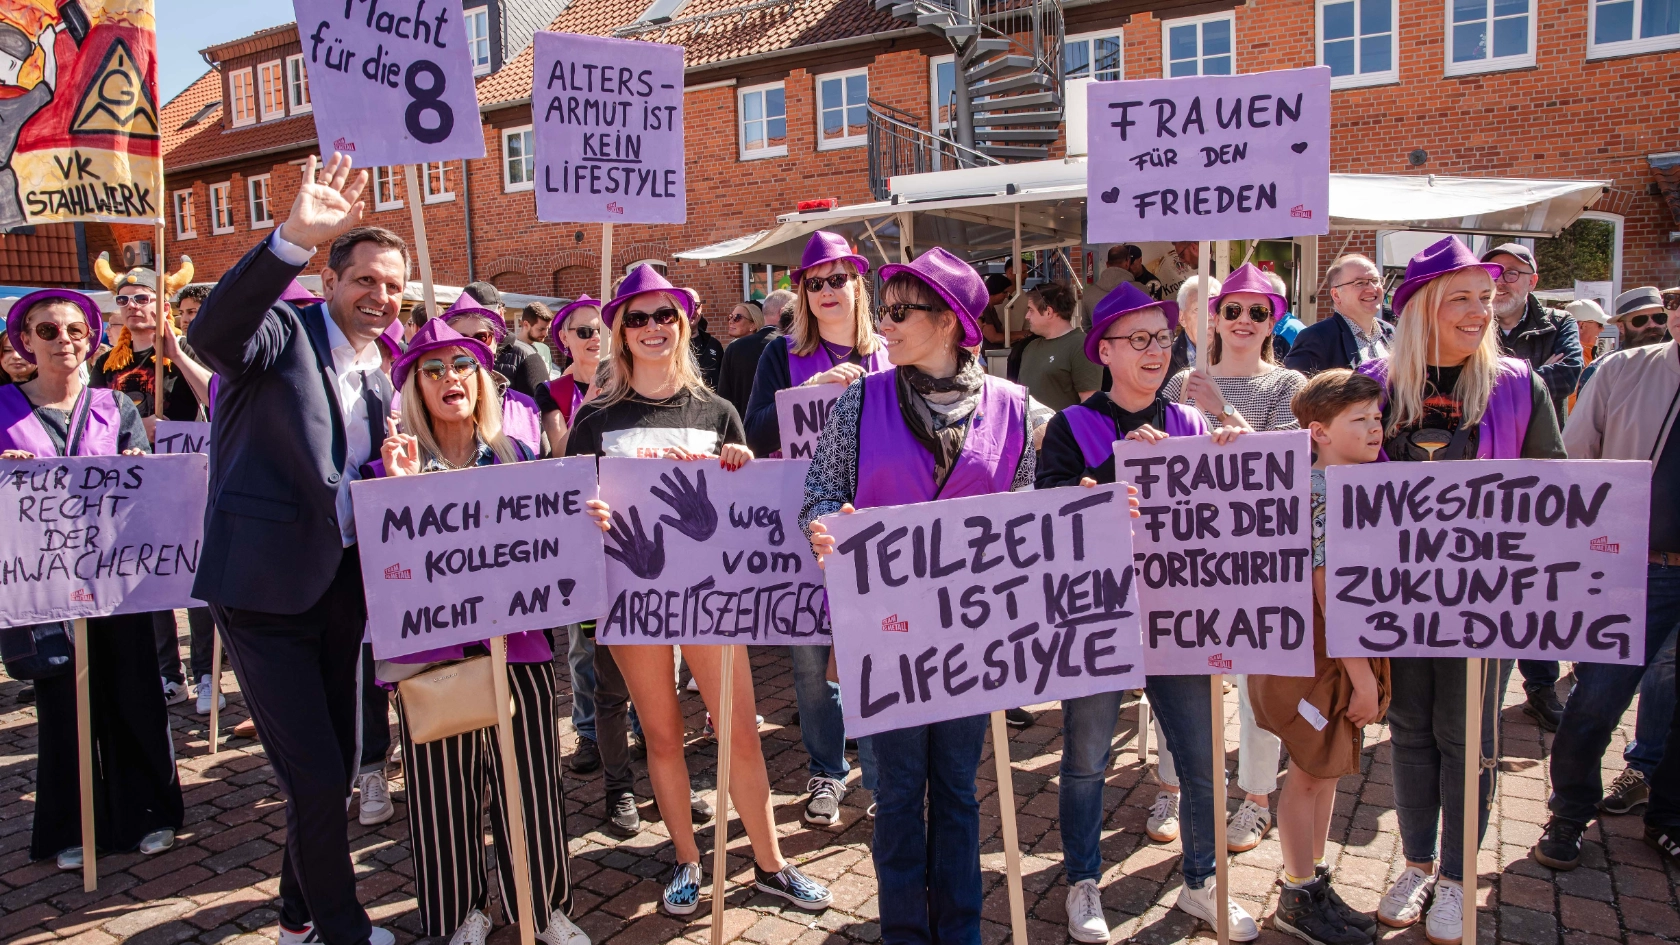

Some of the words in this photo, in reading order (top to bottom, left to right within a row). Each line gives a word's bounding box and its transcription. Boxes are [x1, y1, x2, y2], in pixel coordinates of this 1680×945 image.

[310, 21, 355, 74] für
[362, 44, 400, 89] die
[404, 59, 455, 144] 8
[545, 96, 632, 127] ARMUT
[1108, 93, 1303, 141] FRAUEN
[54, 150, 100, 180] VK
[1129, 148, 1177, 171] FÜR
[1200, 142, 1247, 168] DEN
[26, 182, 155, 217] STAHLWERK
[1132, 181, 1277, 218] FRIEDEN
[10, 464, 67, 491] FÜR
[79, 465, 144, 490] DAS
[1124, 450, 1294, 499] FRAUEN
[19, 495, 129, 523] RECHT
[381, 500, 481, 543] MACH
[496, 489, 581, 523] MEINE
[1139, 500, 1220, 542] FÜR
[1229, 496, 1299, 537] DEN
[1342, 472, 1612, 530] INVESTITION
[40, 525, 101, 552] DER
[425, 537, 560, 583] KOLLEGIN
[837, 490, 1115, 595] TEILZEIT
[0, 540, 199, 585] HWÄCHEREN
[722, 550, 802, 574] vom
[401, 596, 485, 639] NICHT
[937, 575, 1030, 630] IST
[1043, 565, 1135, 624] KEIN
[1149, 609, 1222, 649] FCK
[1226, 606, 1305, 650] AFD
[1358, 610, 1631, 660] BILDUNG
[860, 622, 1135, 718] LIFESTYLE
